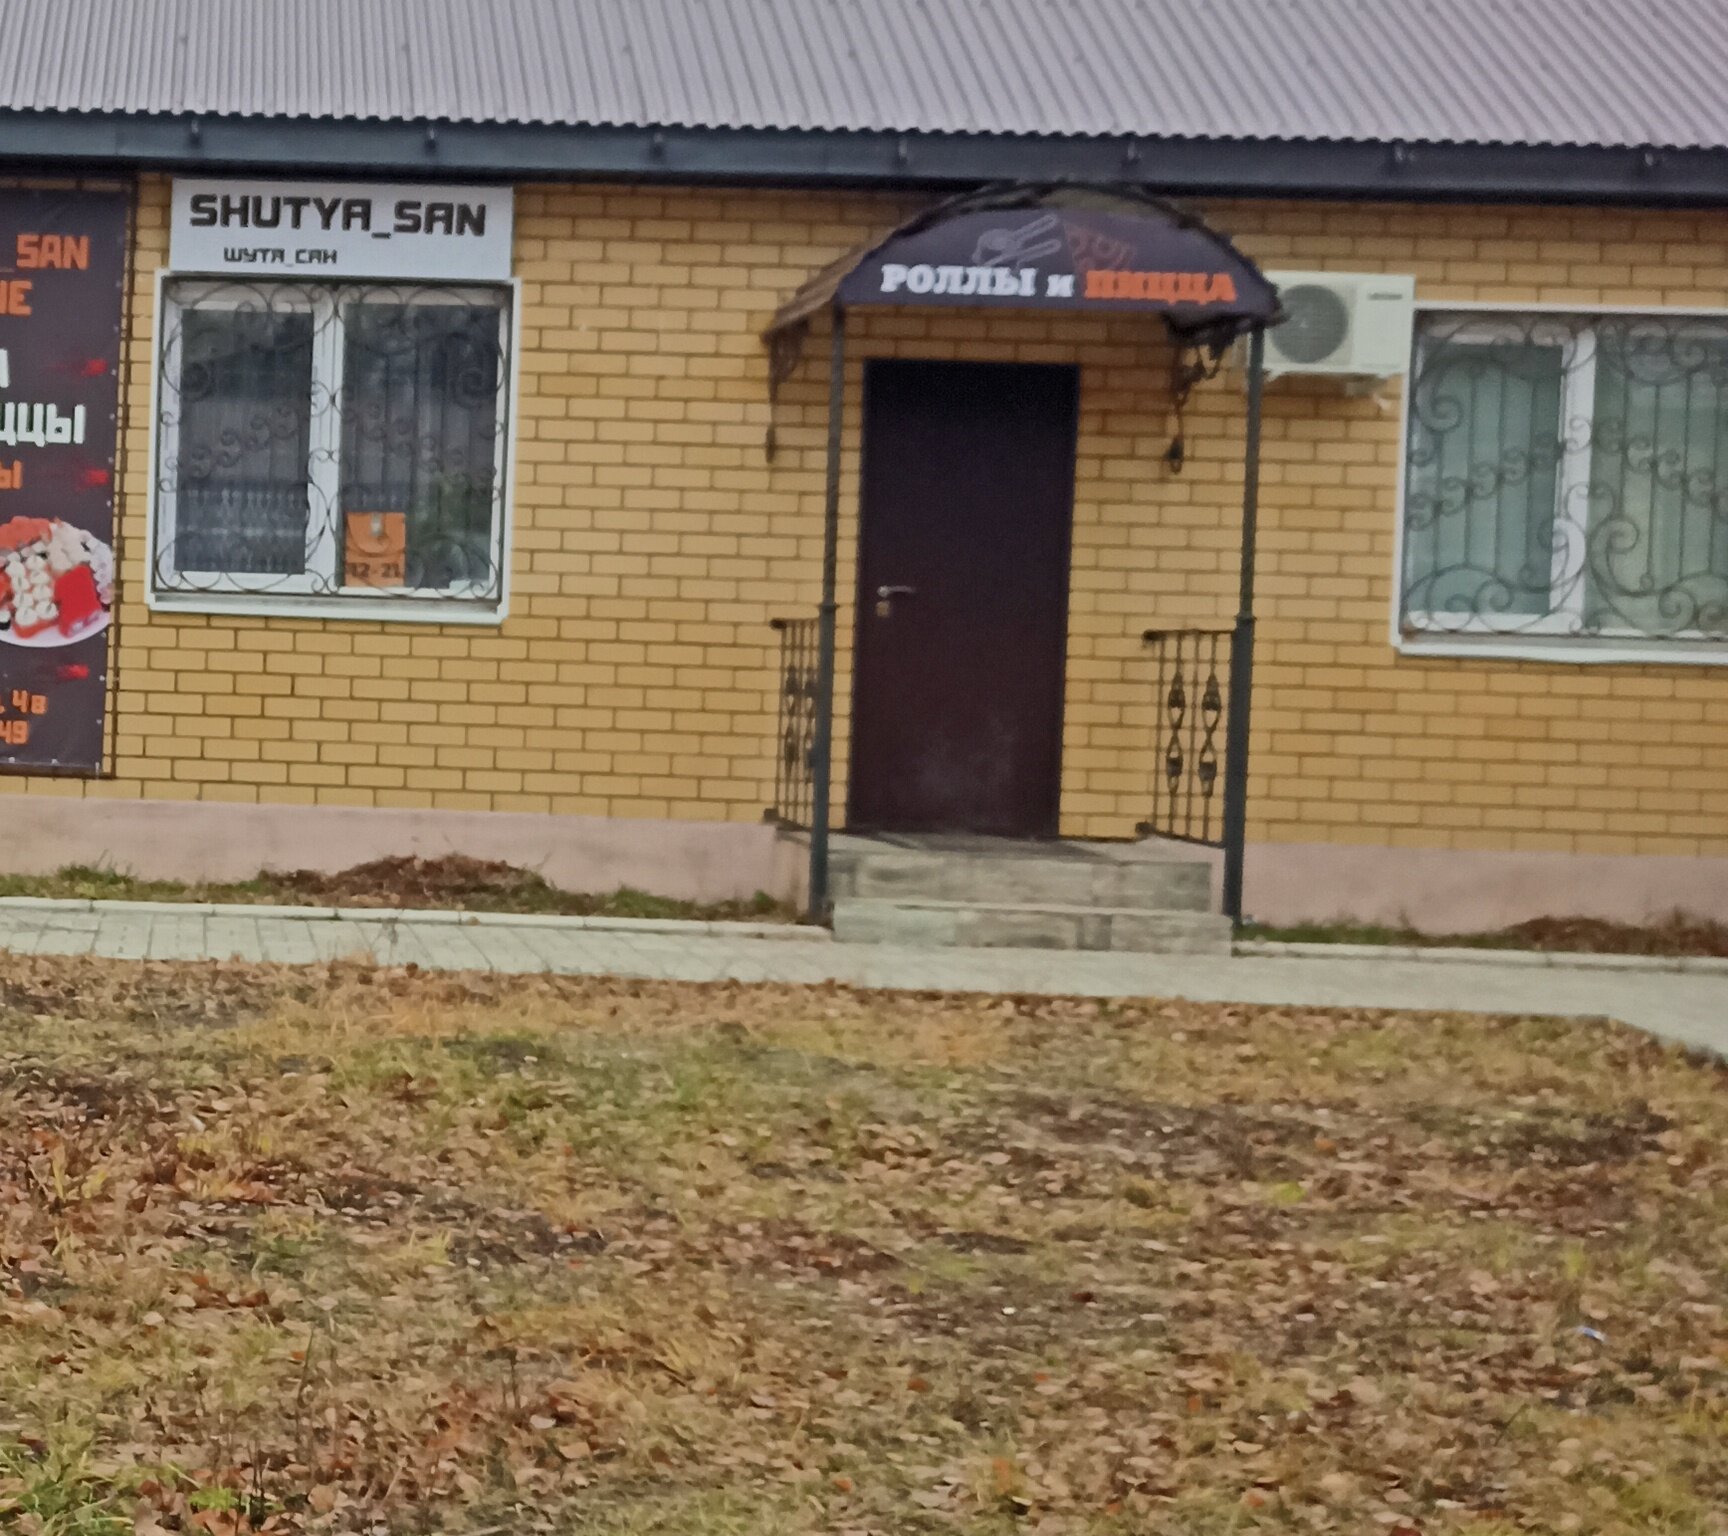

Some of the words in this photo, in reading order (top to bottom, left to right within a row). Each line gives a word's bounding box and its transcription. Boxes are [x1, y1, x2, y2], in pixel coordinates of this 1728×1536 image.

[190, 193, 487, 239] SHUTYA_SAN
[880, 264, 1038, 298] РОЛЛЫ
[1045, 273, 1075, 298] и
[1084, 270, 1238, 305] ПИЦЦА
